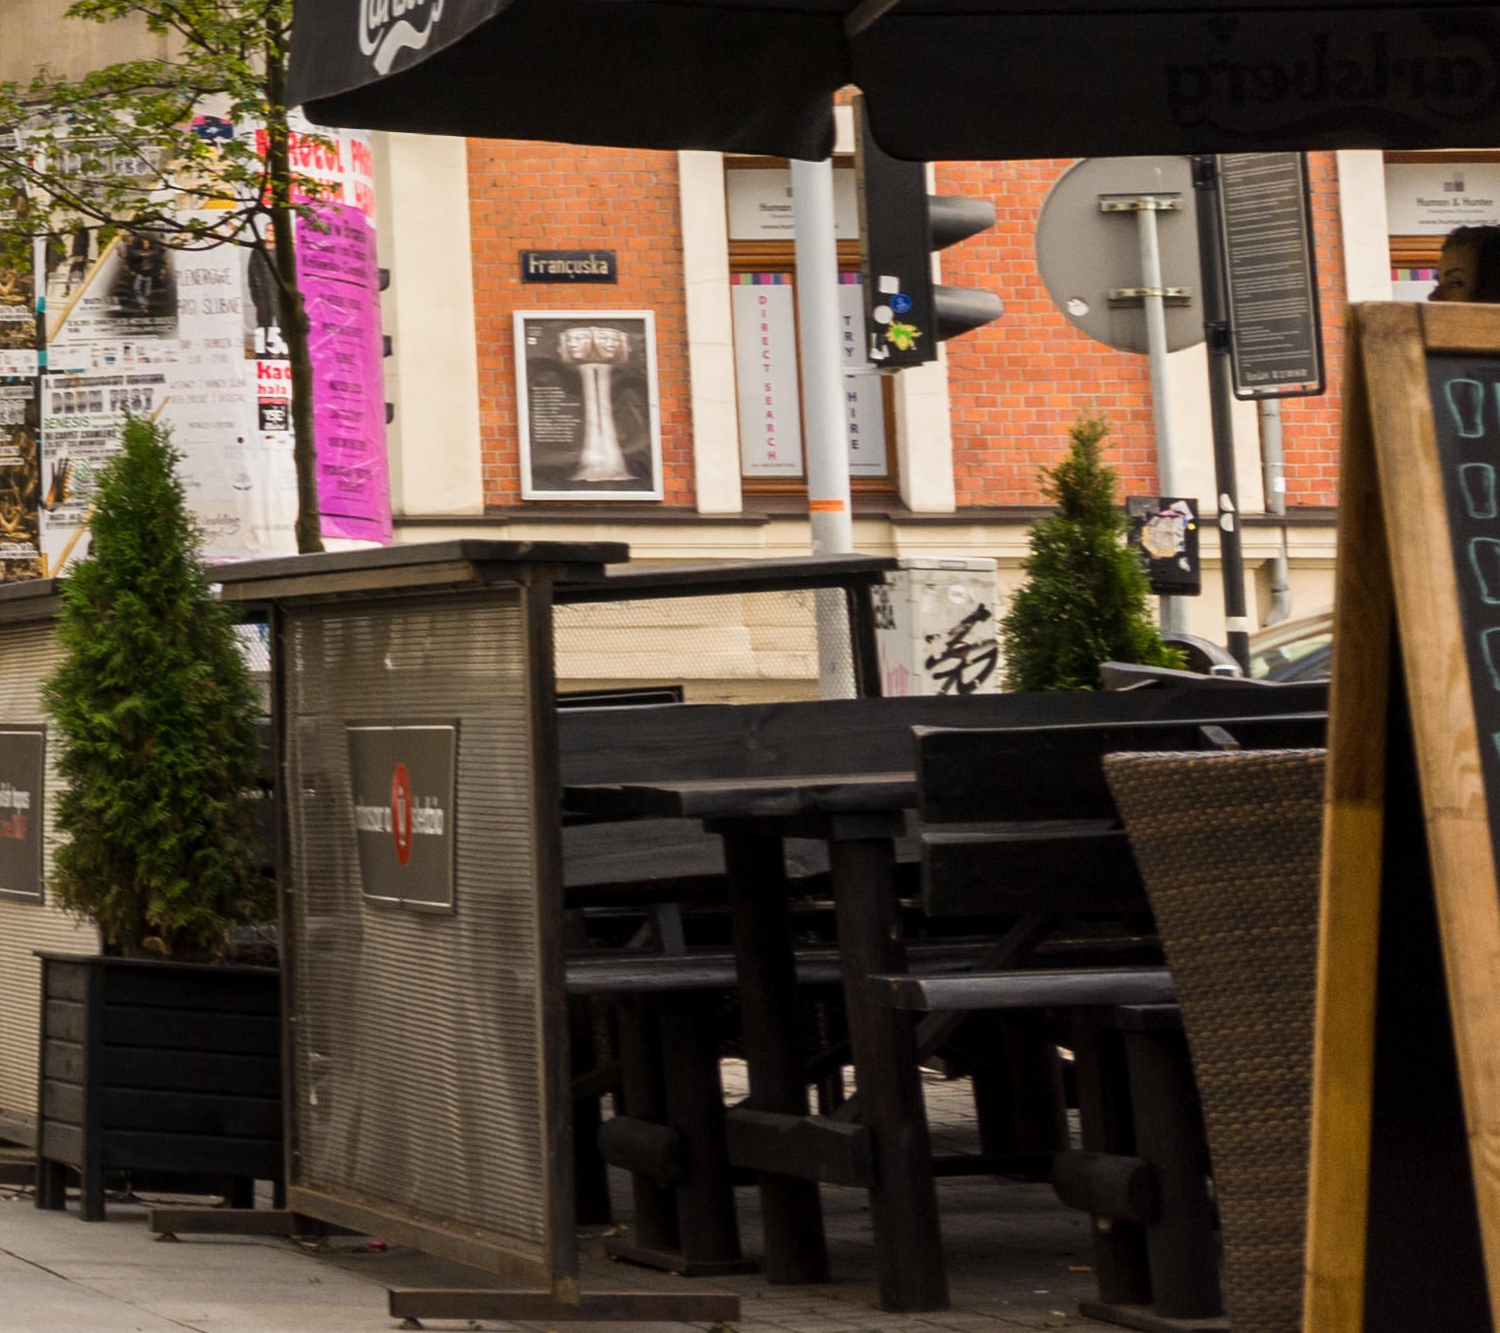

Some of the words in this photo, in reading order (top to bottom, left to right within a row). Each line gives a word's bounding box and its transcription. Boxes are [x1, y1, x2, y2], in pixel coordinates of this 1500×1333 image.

[758, 295, 772, 374] DIRECT
[763, 382, 778, 461] SEARCH
[846, 392, 860, 451] HIRE
